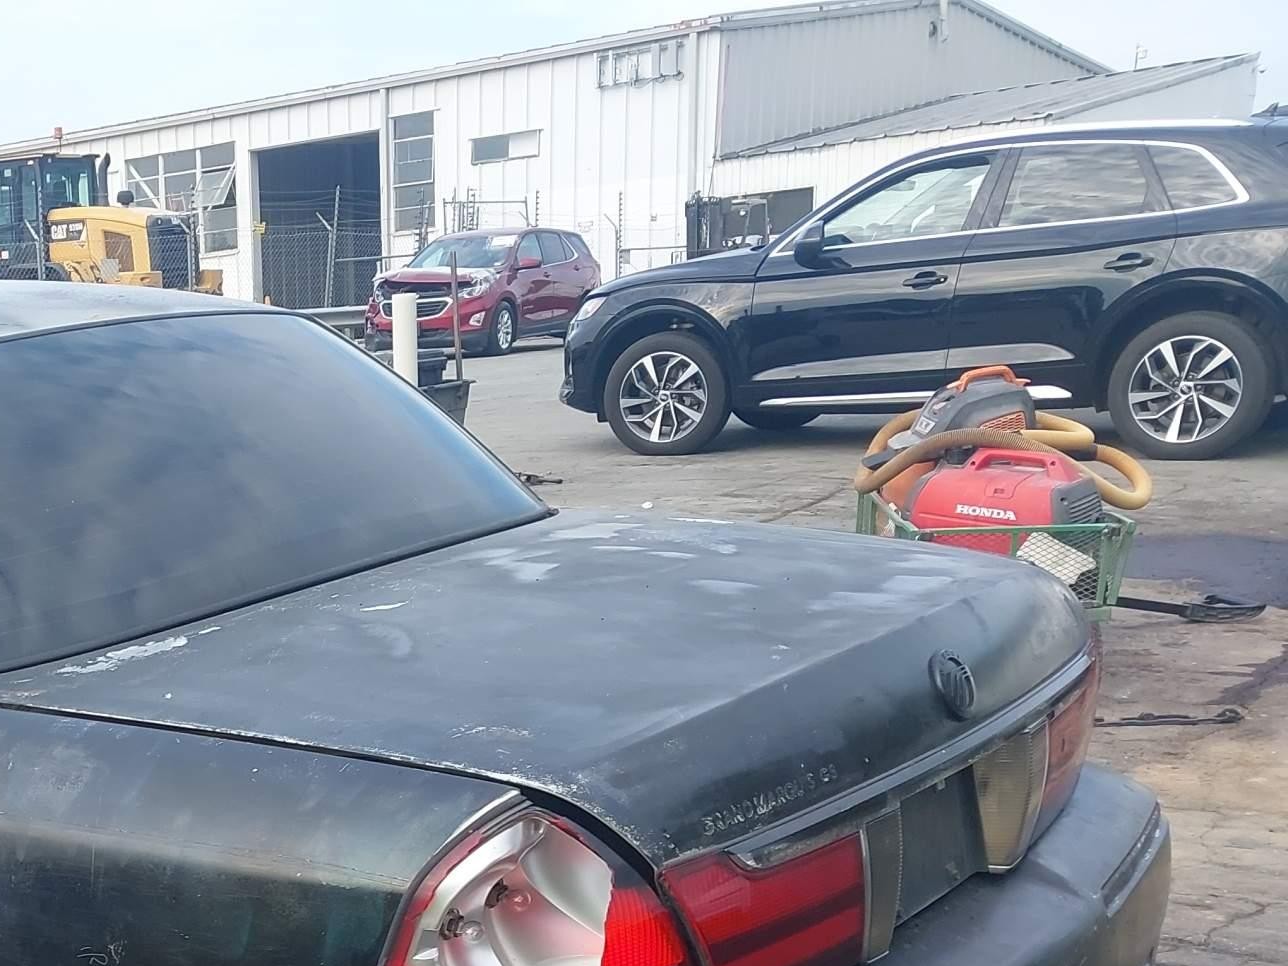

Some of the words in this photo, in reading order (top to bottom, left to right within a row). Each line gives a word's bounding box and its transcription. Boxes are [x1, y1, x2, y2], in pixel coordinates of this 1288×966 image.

[50, 224, 67, 240] CAT
[955, 504, 1017, 521] HONDA
[753, 772, 816, 815] MARQUS
